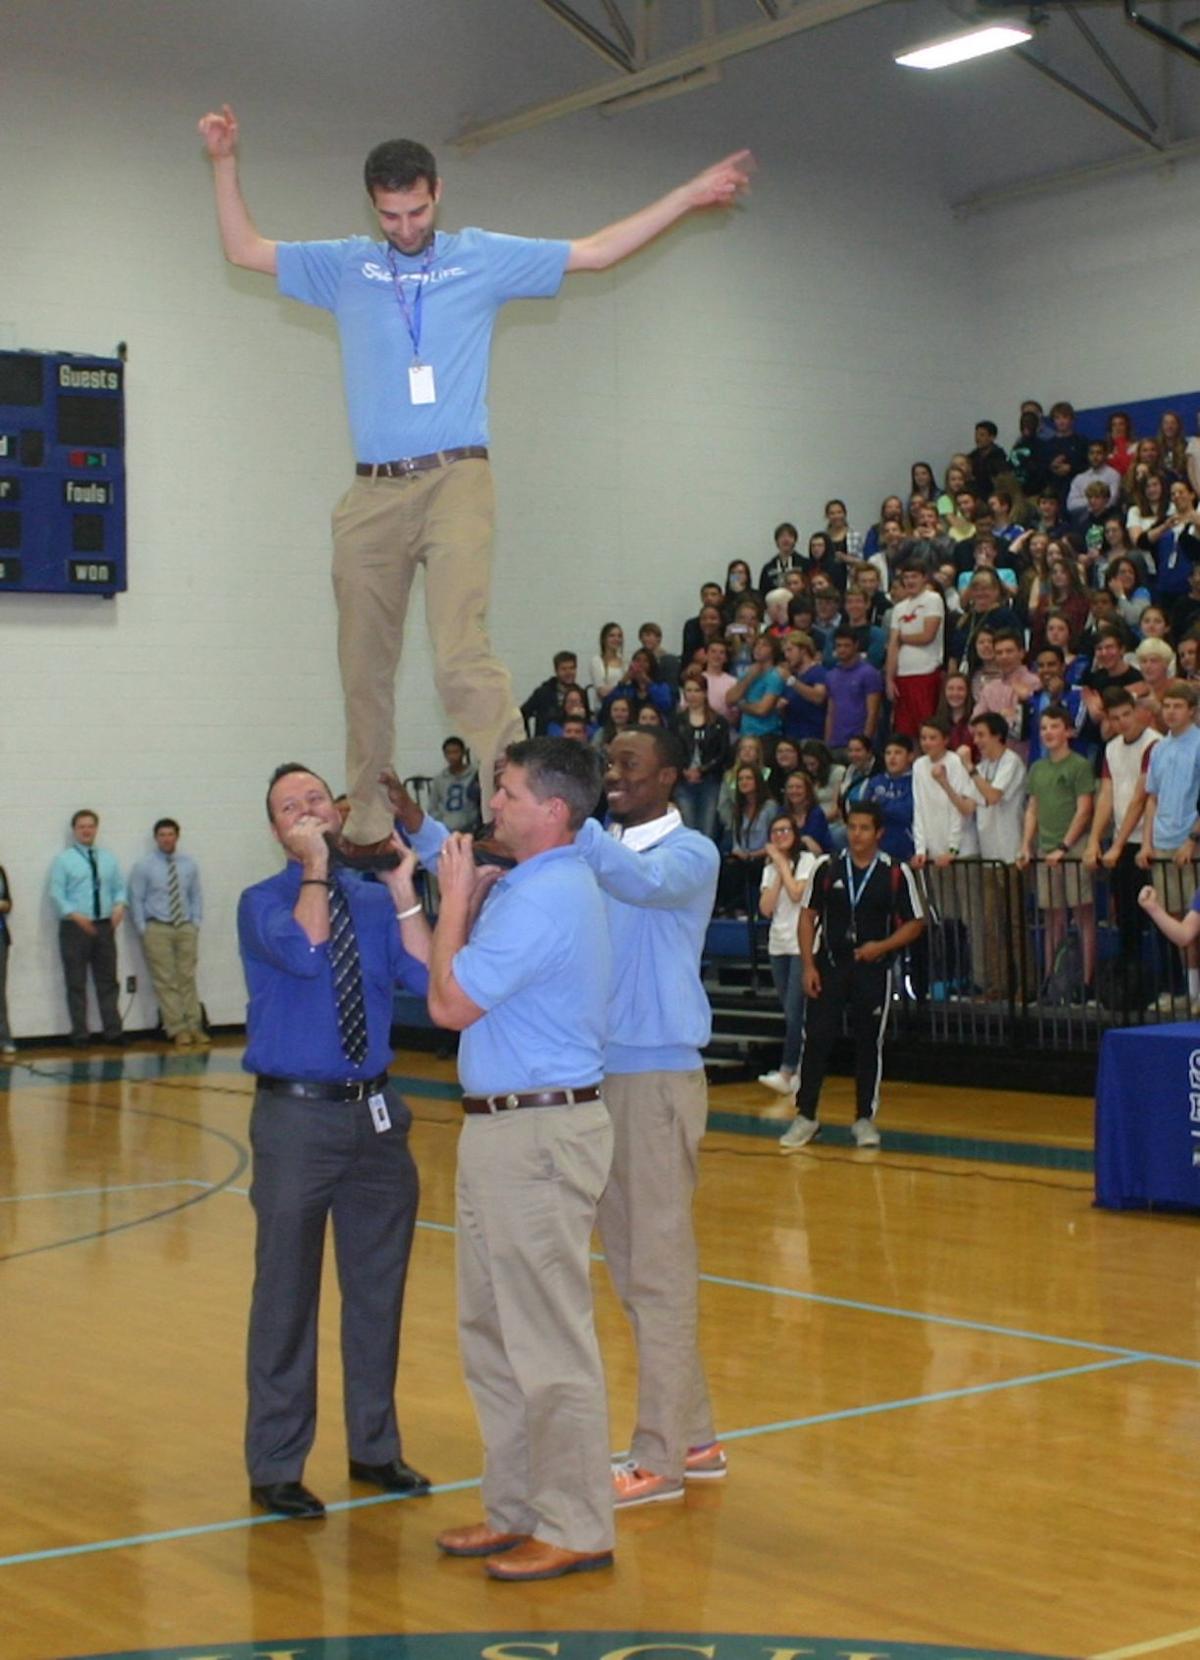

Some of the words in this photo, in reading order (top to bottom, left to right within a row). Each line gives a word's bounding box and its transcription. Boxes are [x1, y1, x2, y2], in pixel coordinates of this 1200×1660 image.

[59, 364, 118, 389] Guests
[75, 564, 109, 581] won
[445, 783, 464, 812] 8
